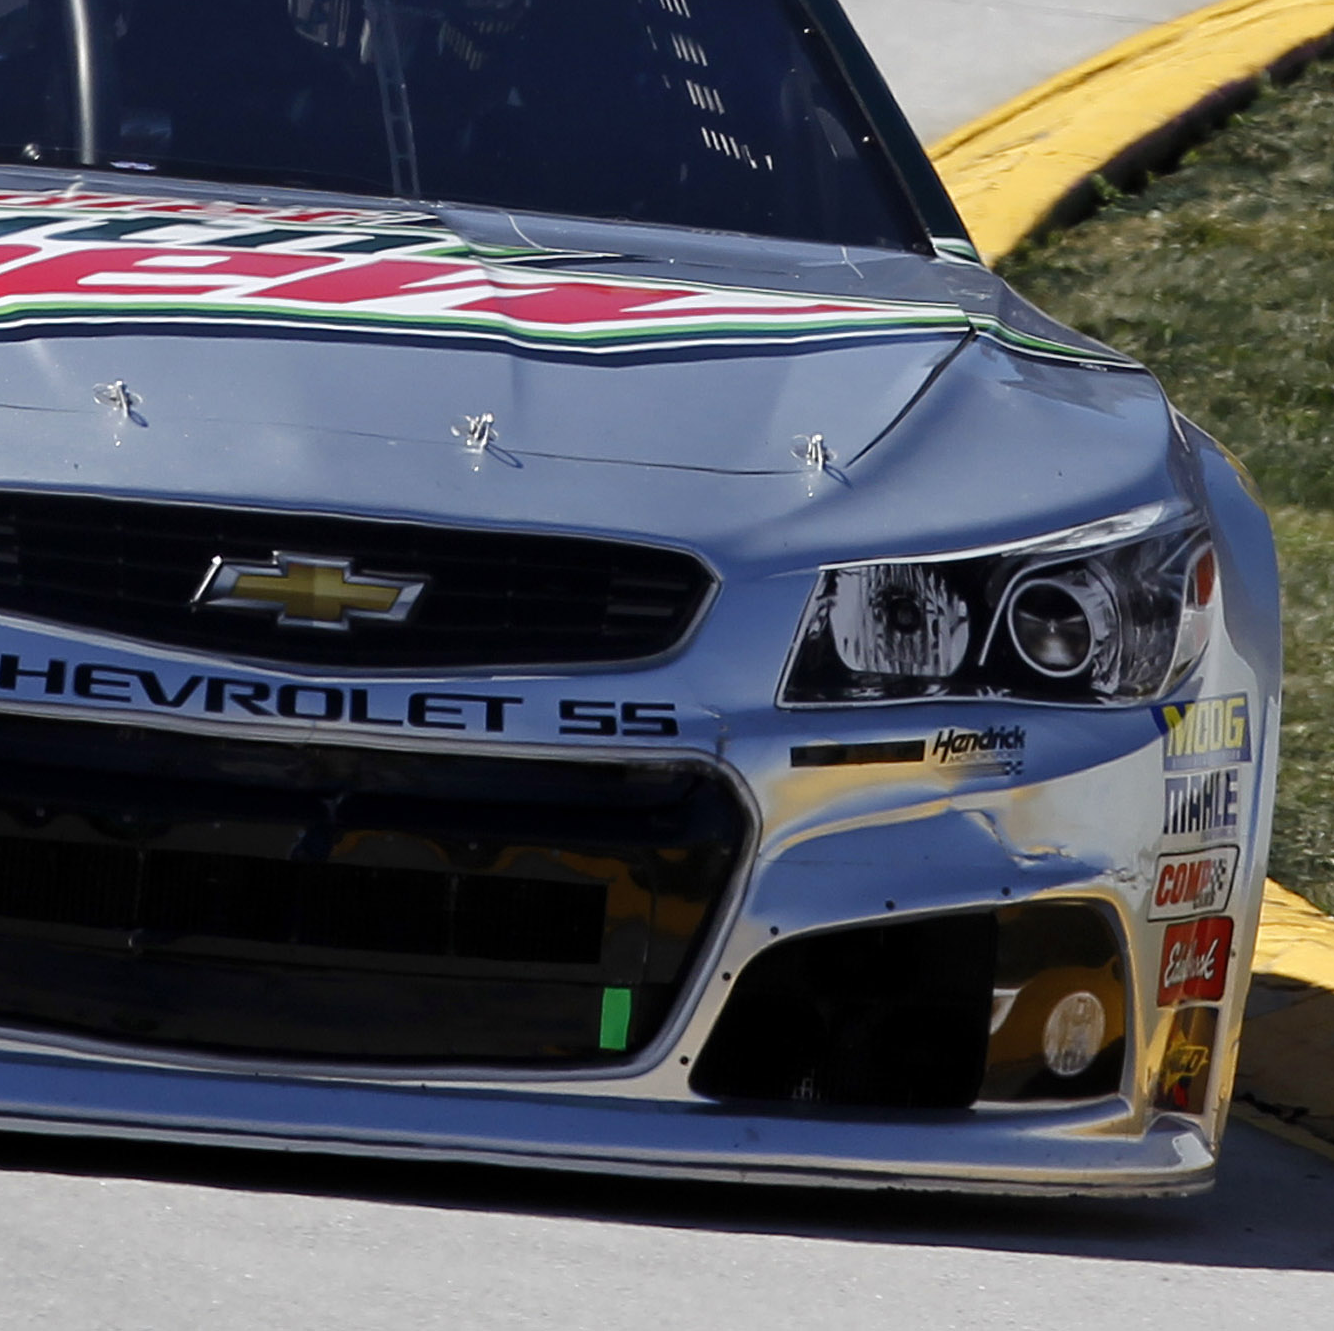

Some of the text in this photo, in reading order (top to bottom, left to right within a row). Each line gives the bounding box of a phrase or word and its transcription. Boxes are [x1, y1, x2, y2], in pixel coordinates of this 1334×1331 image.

[559, 699, 681, 737] SS
[1163, 697, 1246, 757] MOOG
[931, 725, 1026, 764] Hendrick
[1163, 769, 1238, 834] MAHLE
